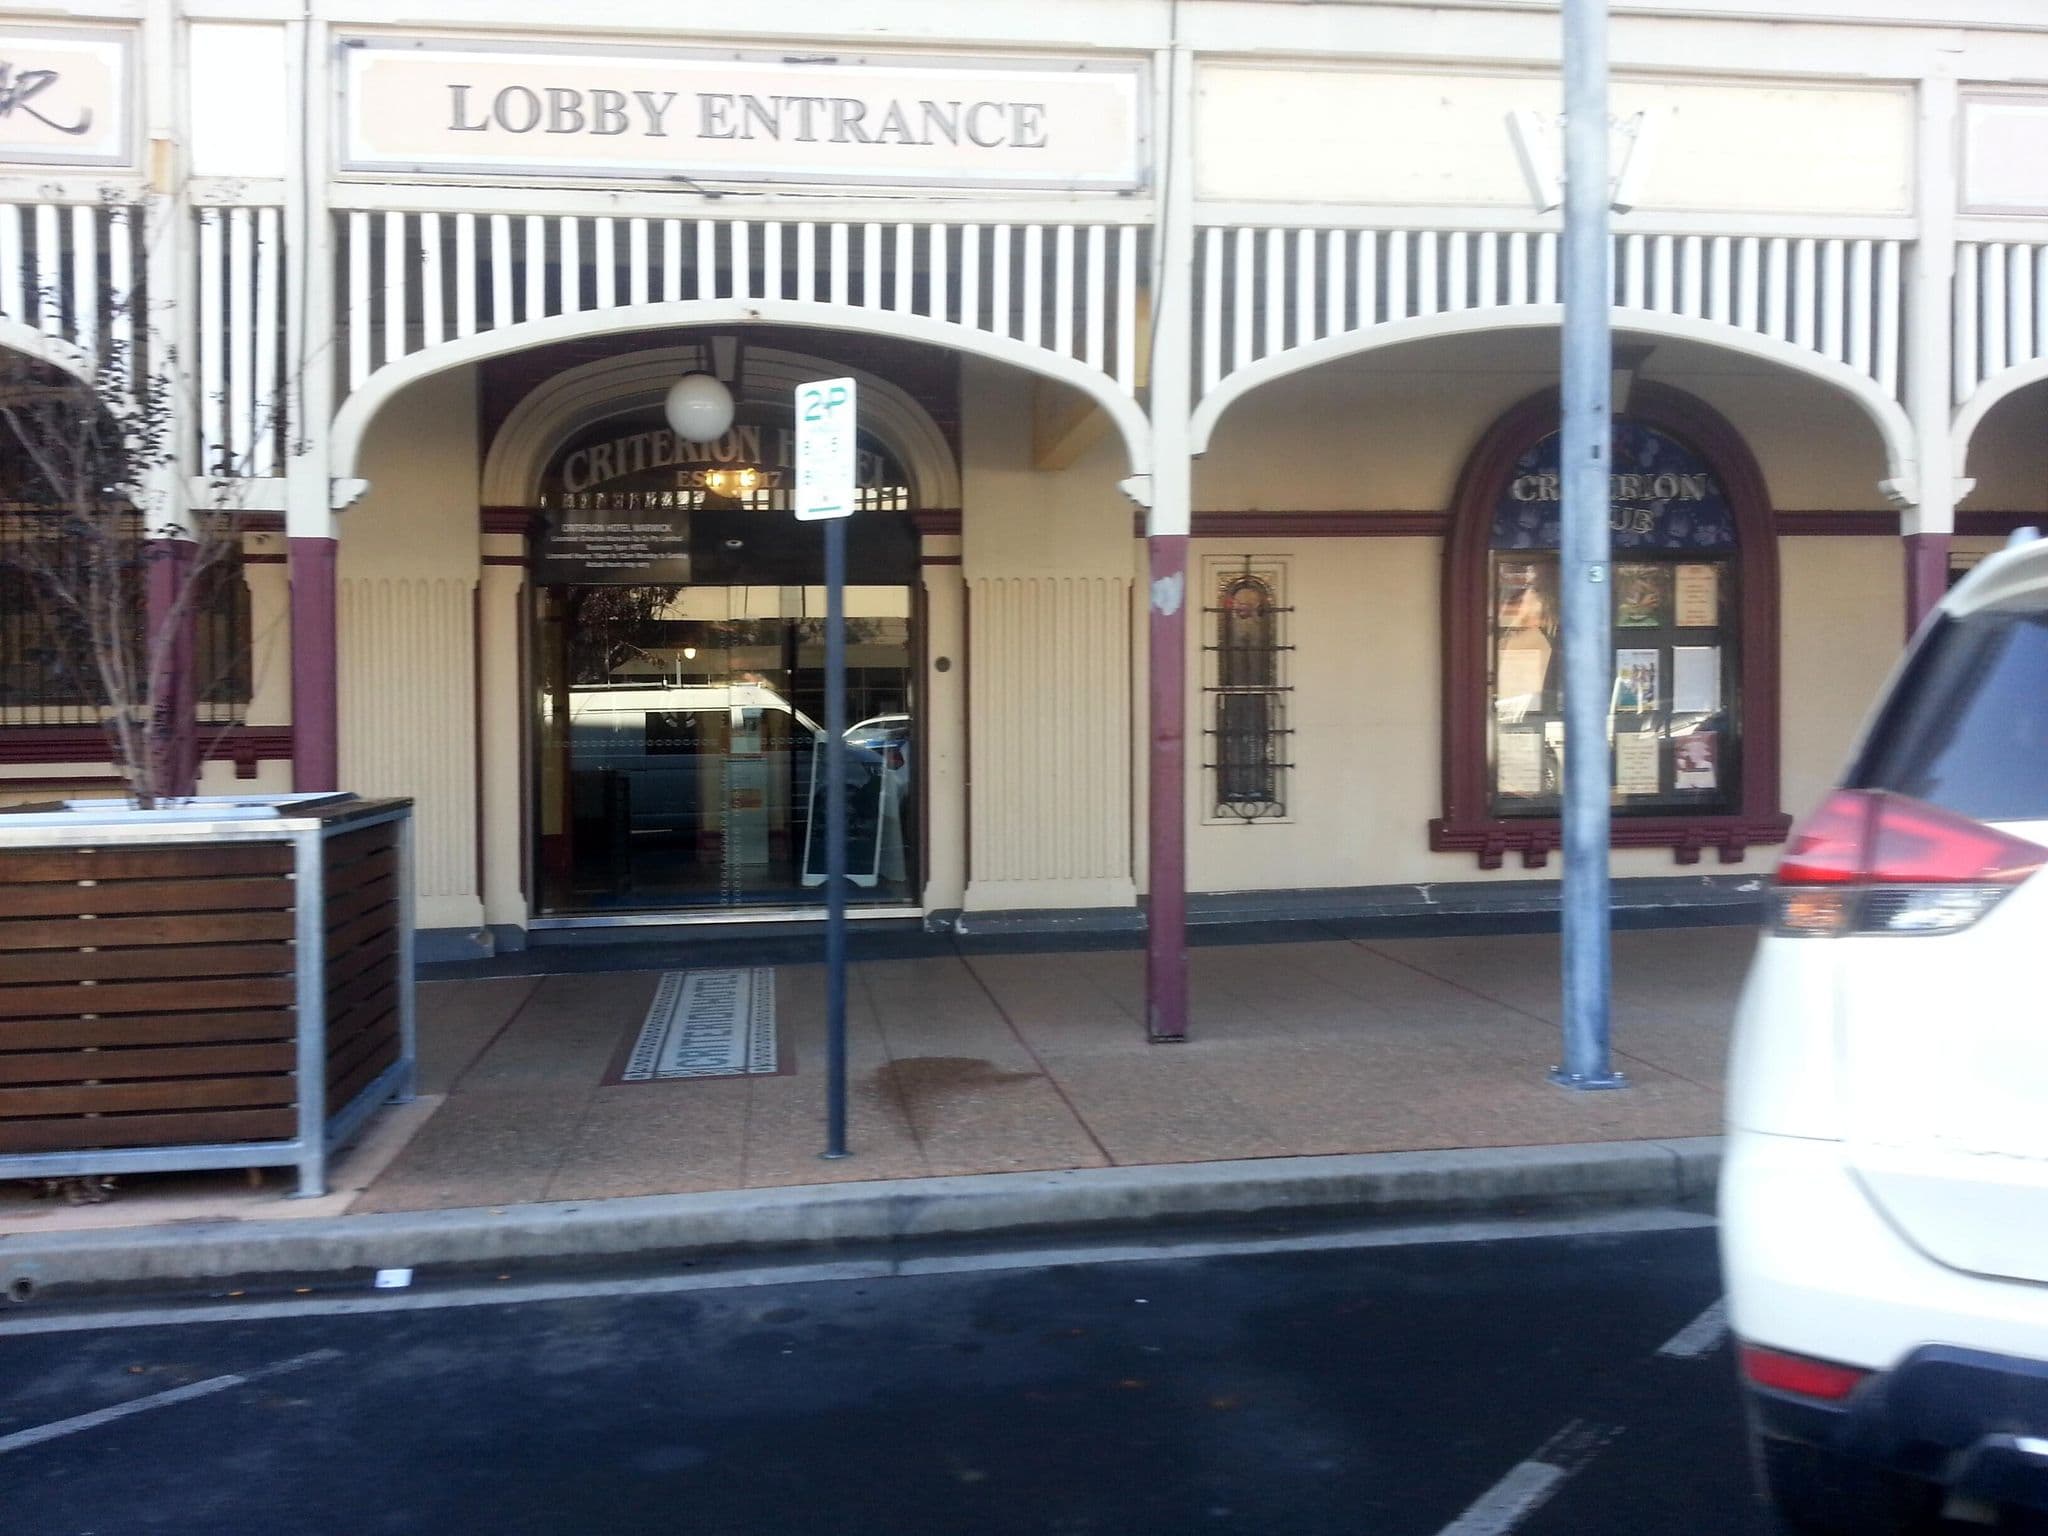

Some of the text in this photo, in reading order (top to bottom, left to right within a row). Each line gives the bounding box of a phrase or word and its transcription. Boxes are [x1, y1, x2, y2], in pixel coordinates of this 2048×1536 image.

[447, 83, 1048, 149] LOBBY ENTRANCE
[804, 386, 848, 422] 2P
[778, 428, 891, 491] HEL
[1511, 473, 1708, 502] CRRION
[676, 1005, 735, 1068] CRITERION
